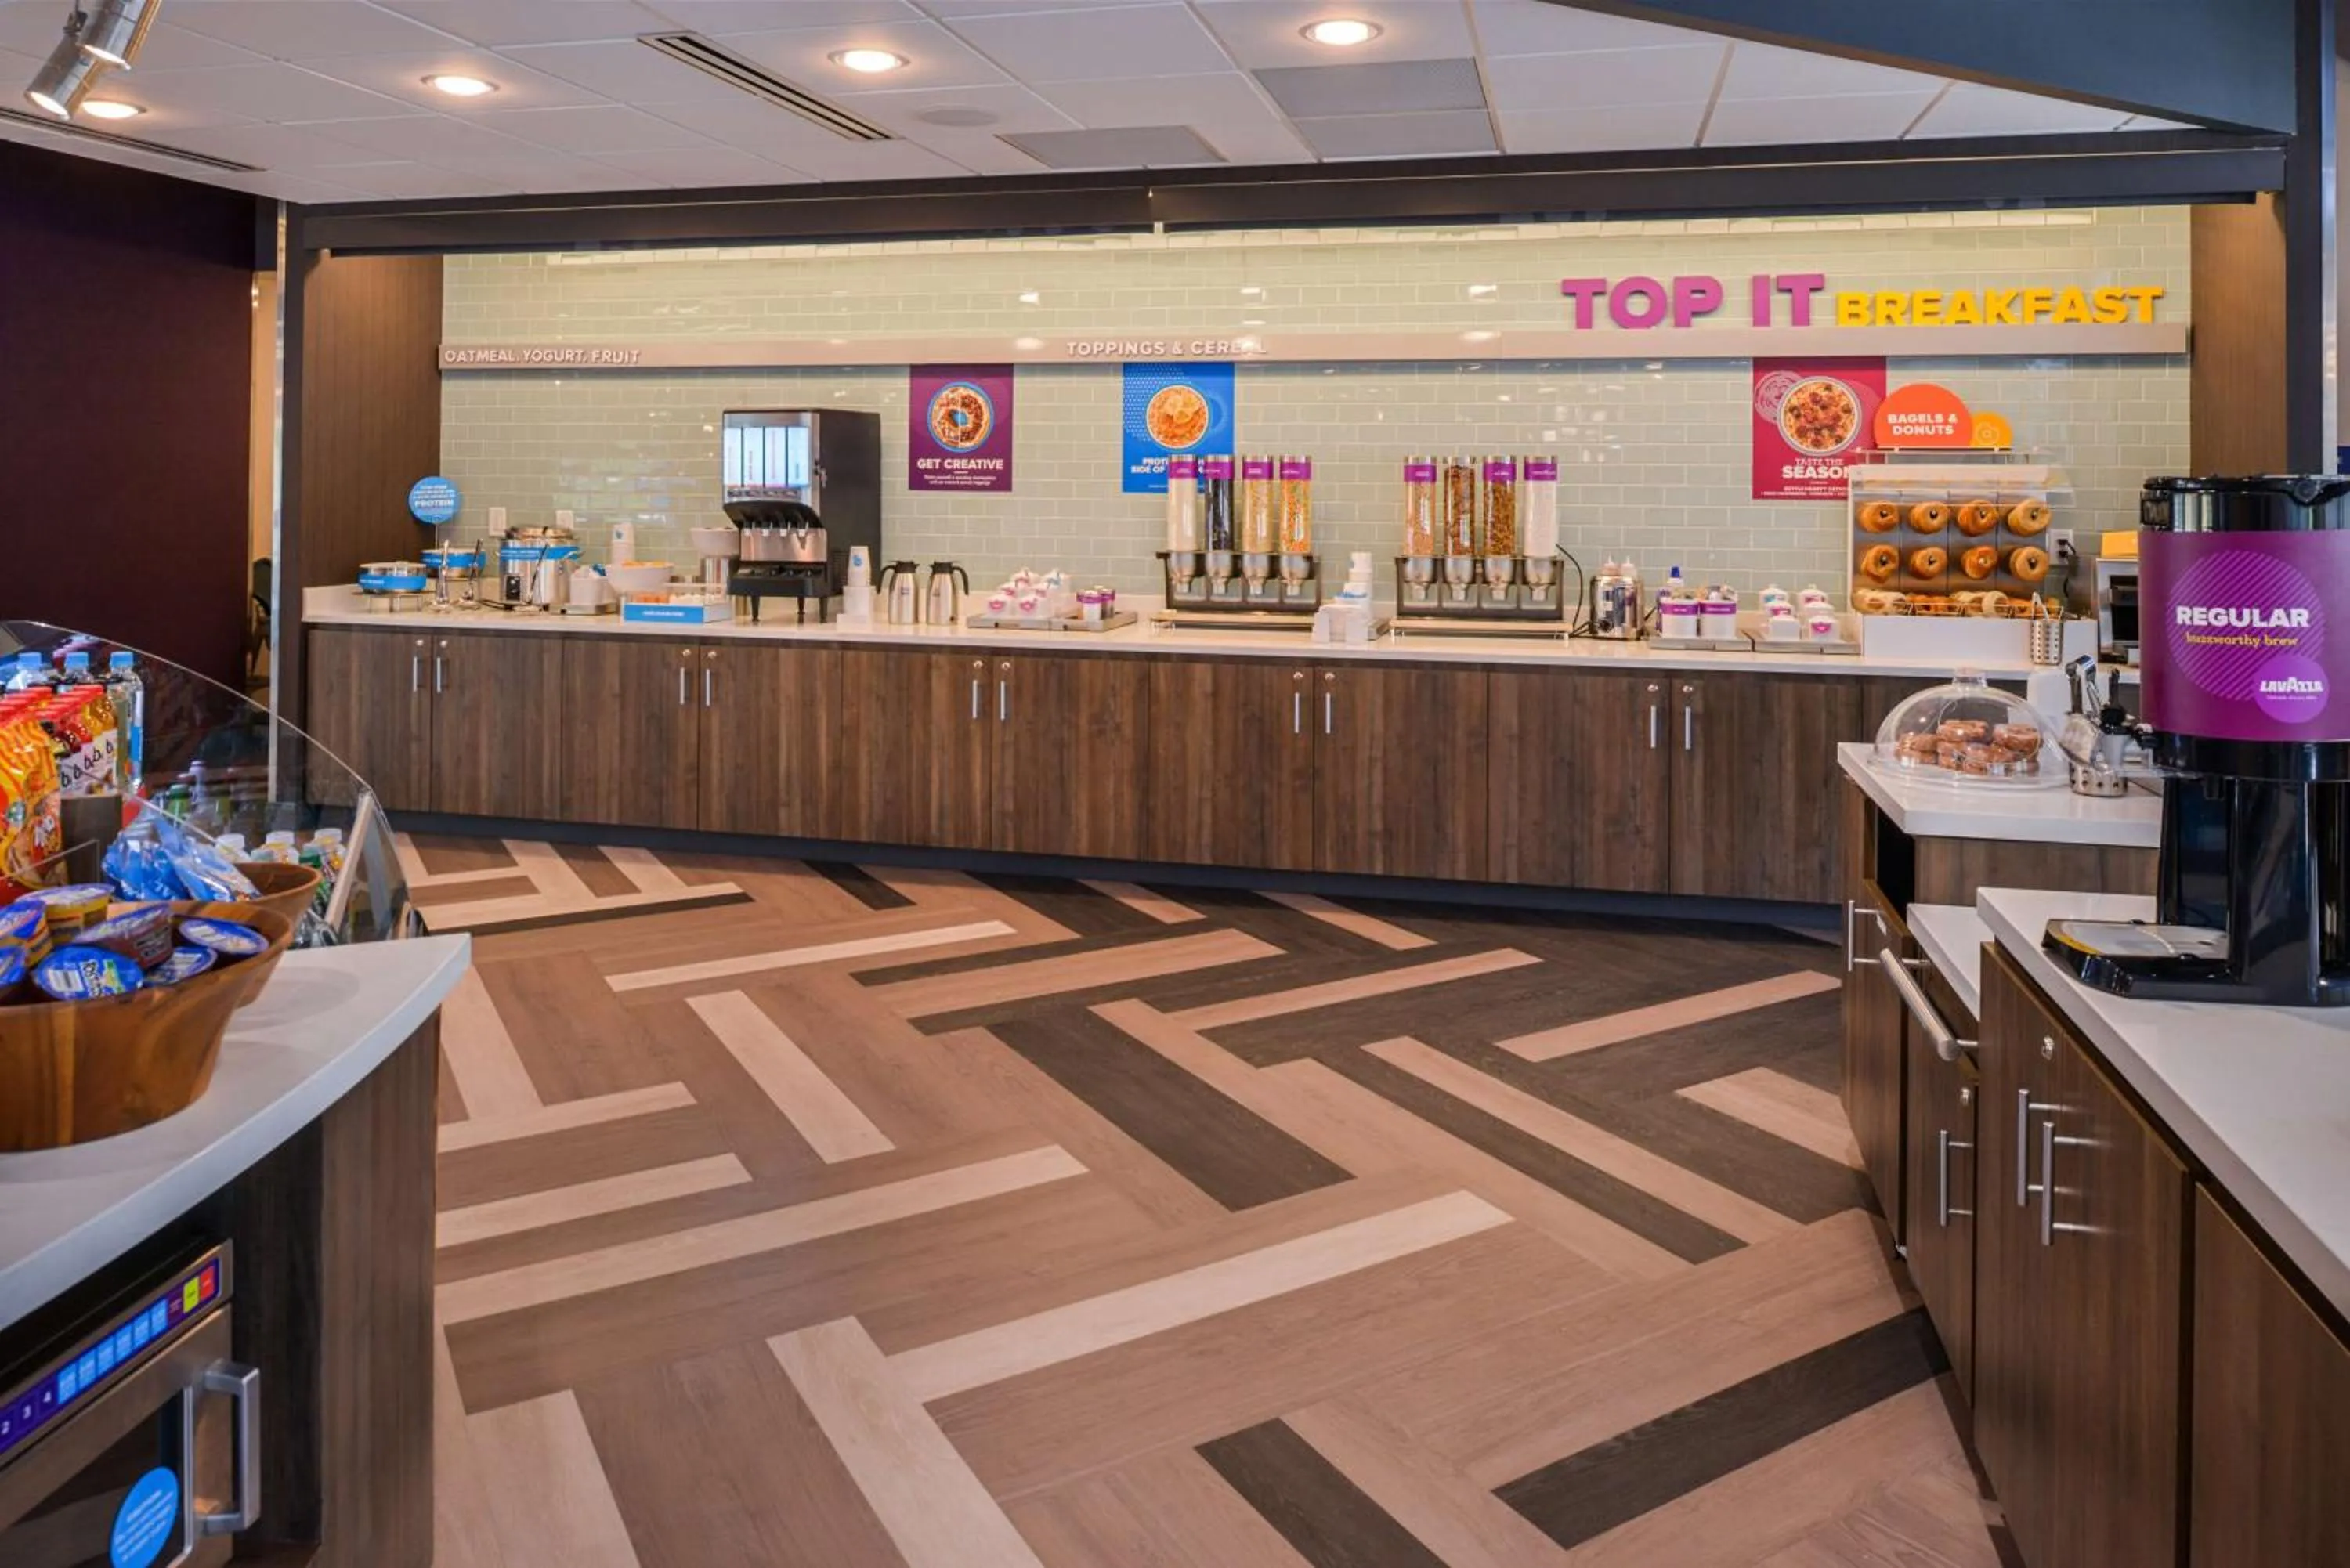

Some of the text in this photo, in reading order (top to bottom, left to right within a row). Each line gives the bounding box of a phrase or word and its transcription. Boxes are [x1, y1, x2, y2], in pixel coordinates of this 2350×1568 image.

[1561, 274, 1824, 329] TOP IT
[1836, 286, 2164, 326] BREAKFAST
[1067, 341, 1166, 356] TOPPINGS
[1172, 341, 1185, 356] &
[591, 349, 640, 363] FRUIT
[1887, 413, 1958, 424] BAGELS &
[1892, 425, 1954, 435] DONUTS
[917, 458, 1003, 469] GET CREATIVE
[1142, 457, 1169, 466] PROT
[1131, 465, 1151, 474] SIDE
[1152, 465, 1166, 474] OF
[414, 500, 454, 508] PROTEIN
[2176, 605, 2309, 627] REGULAR
[2186, 631, 2299, 649] buzzworthy brew
[2259, 677, 2323, 693] LAVAZZA
[43, 1391, 52, 1404] 4
[23, 1405, 31, 1420] 3
[1, 1421, 10, 1436] 2
